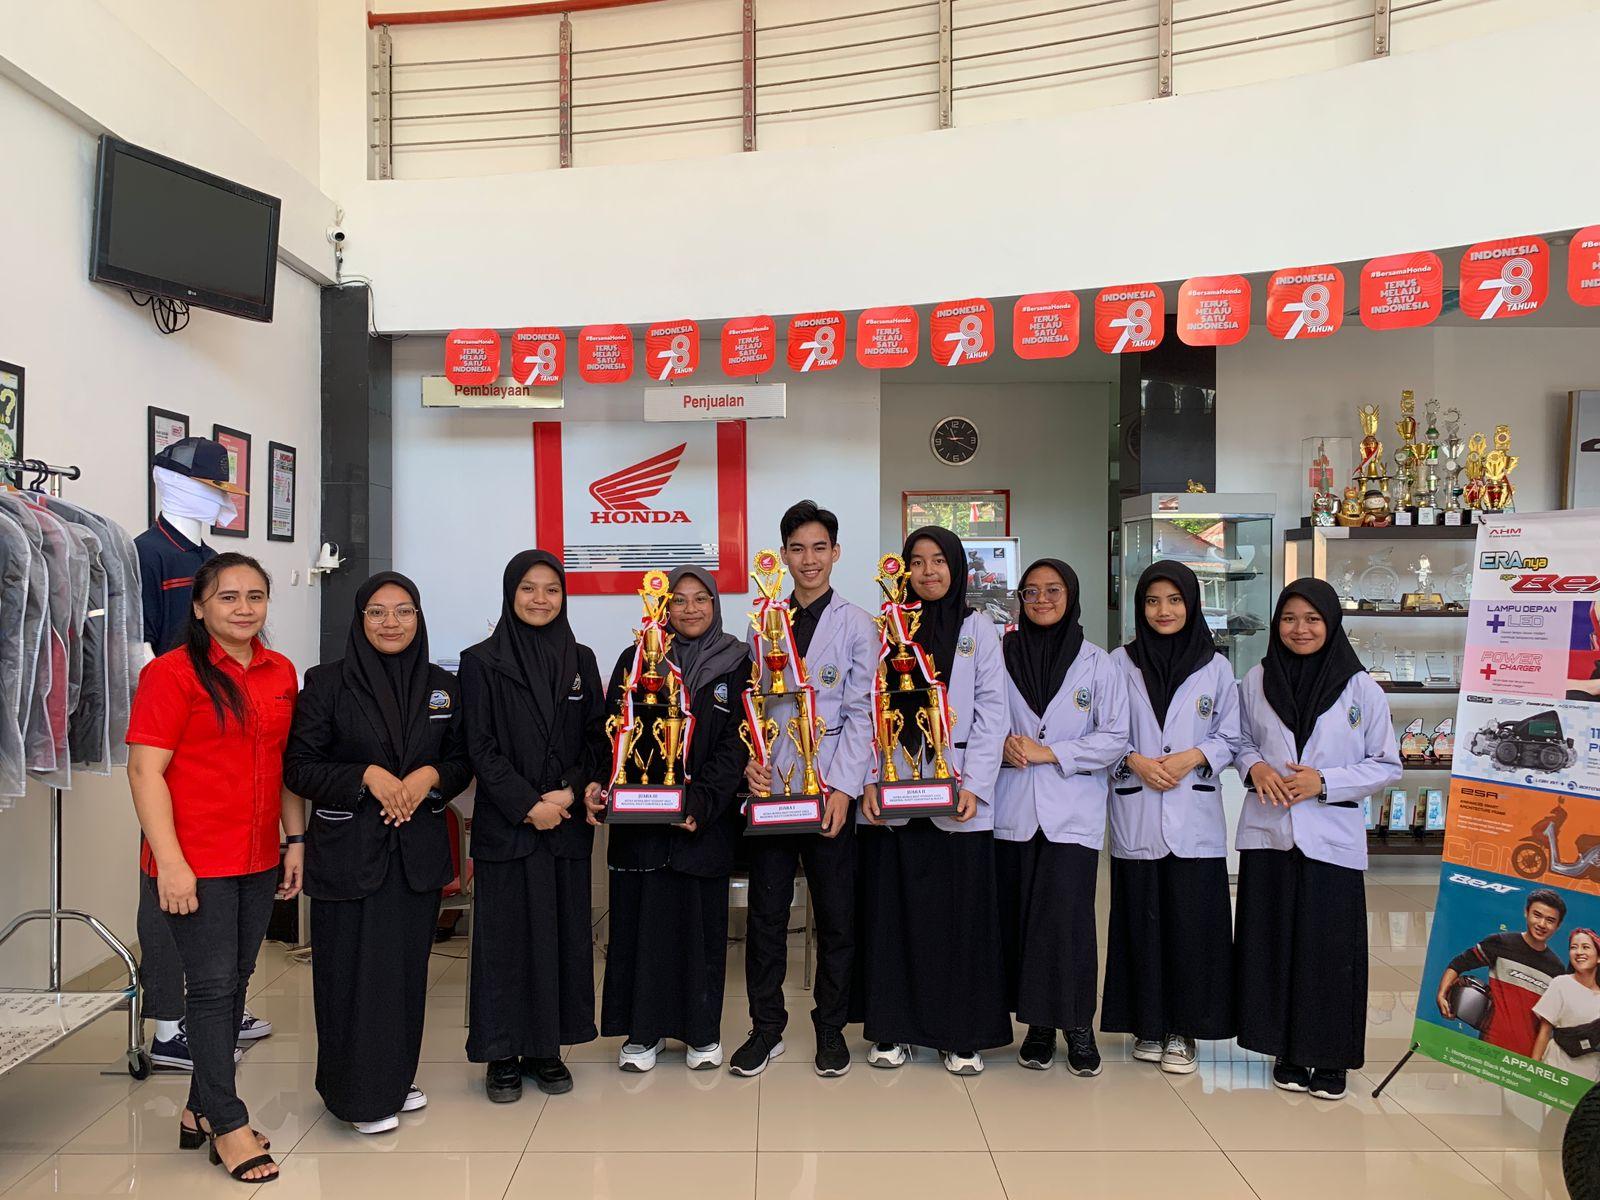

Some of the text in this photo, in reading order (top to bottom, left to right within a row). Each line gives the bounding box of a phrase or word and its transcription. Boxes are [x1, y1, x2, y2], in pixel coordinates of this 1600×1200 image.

[1471, 244, 1539, 261] INDONESIA
[1371, 266, 1432, 278] #BersamaHonda
[1276, 273, 1335, 285] INDONESIA
[1384, 279, 1417, 289] TERUS
[1380, 287, 1421, 297] MELAJU
[1478, 258, 1533, 320] 78
[1102, 290, 1156, 302] INDONESIA
[1386, 295, 1414, 304] SATU
[1022, 303, 1071, 312] #BersamaHonda
[1200, 300, 1229, 308] TERUS
[1371, 301, 1430, 314] INDONESIA
[1507, 301, 1537, 311] TAHUN
[937, 305, 986, 318] INDONESIA
[1196, 307, 1231, 315] MELAJU
[1282, 284, 1330, 339] 78
[795, 317, 839, 327] INDONESIA
[1033, 314, 1059, 323] TERUS
[1030, 321, 1062, 330] MELAJU
[1109, 301, 1151, 353] 78
[1187, 322, 1239, 330] INDONESIA
[1307, 325, 1334, 333] TAHUN
[651, 326, 693, 336] INDONESIA
[1034, 329, 1057, 337] SATU
[738, 336, 760, 344] TERUS
[944, 315, 983, 366] 78
[1022, 335, 1069, 345] INDONESIA
[735, 342, 762, 351] MELAJU
[800, 326, 835, 372] 78
[657, 335, 690, 380] 78
[729, 354, 767, 364] INDONESIA
[965, 351, 988, 359] TAHUN
[523, 342, 556, 385] 78
[454, 384, 530, 399] Pembiayaan
[683, 394, 744, 411] Penjualan
[970, 436, 976, 445] 3
[953, 454, 960, 462] 6
[590, 511, 692, 524] HONDA
[1487, 605, 1557, 613] LAMPU DEPAN
[1508, 615, 1544, 628] LED
[1481, 651, 1543, 665] POWER
[1499, 664, 1542, 672] CHARGER
[1502, 1055, 1569, 1086] APPARELS
